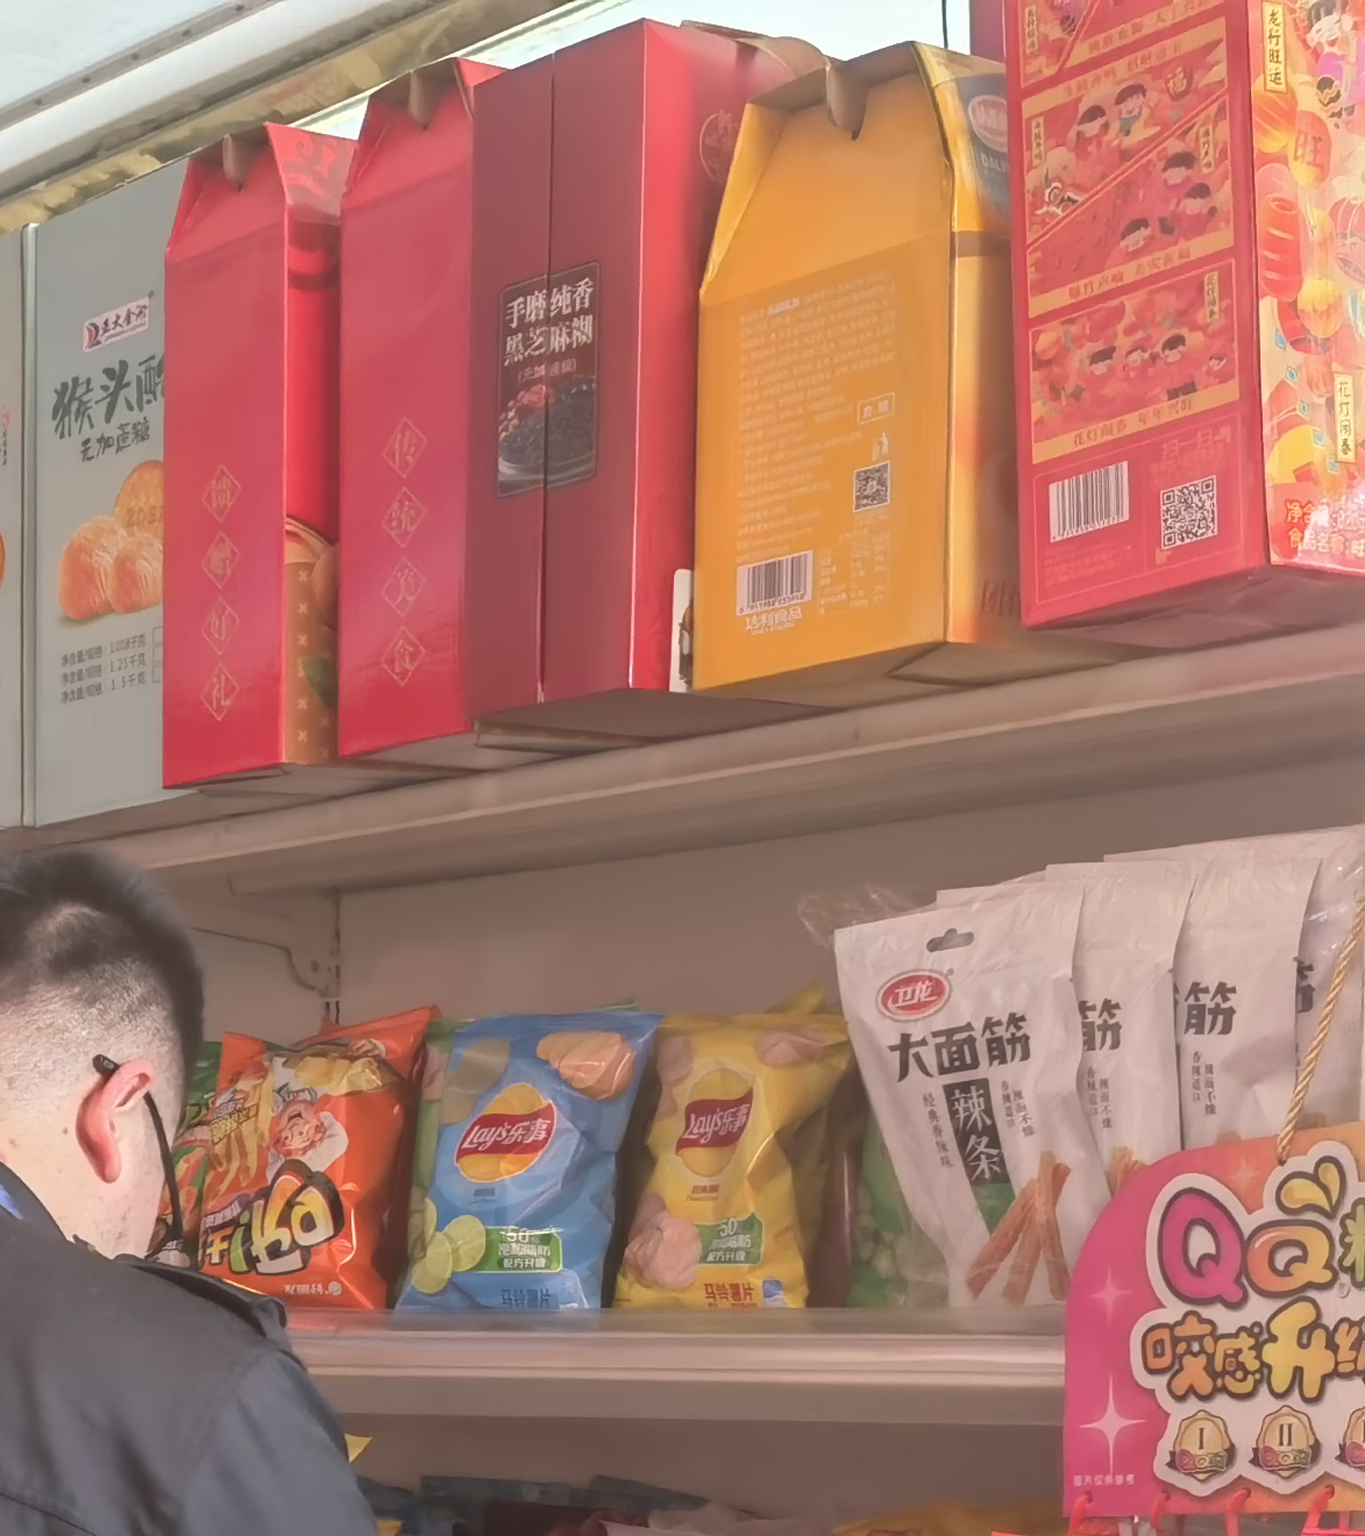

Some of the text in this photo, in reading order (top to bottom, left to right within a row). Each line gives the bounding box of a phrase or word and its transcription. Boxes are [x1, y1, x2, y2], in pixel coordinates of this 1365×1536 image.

[505, 277, 594, 329] 手磨纯香
[503, 314, 594, 367] 黑芝麻糊
[887, 1011, 1032, 1083] 大面筋
[949, 1084, 1005, 1181] 辣条
